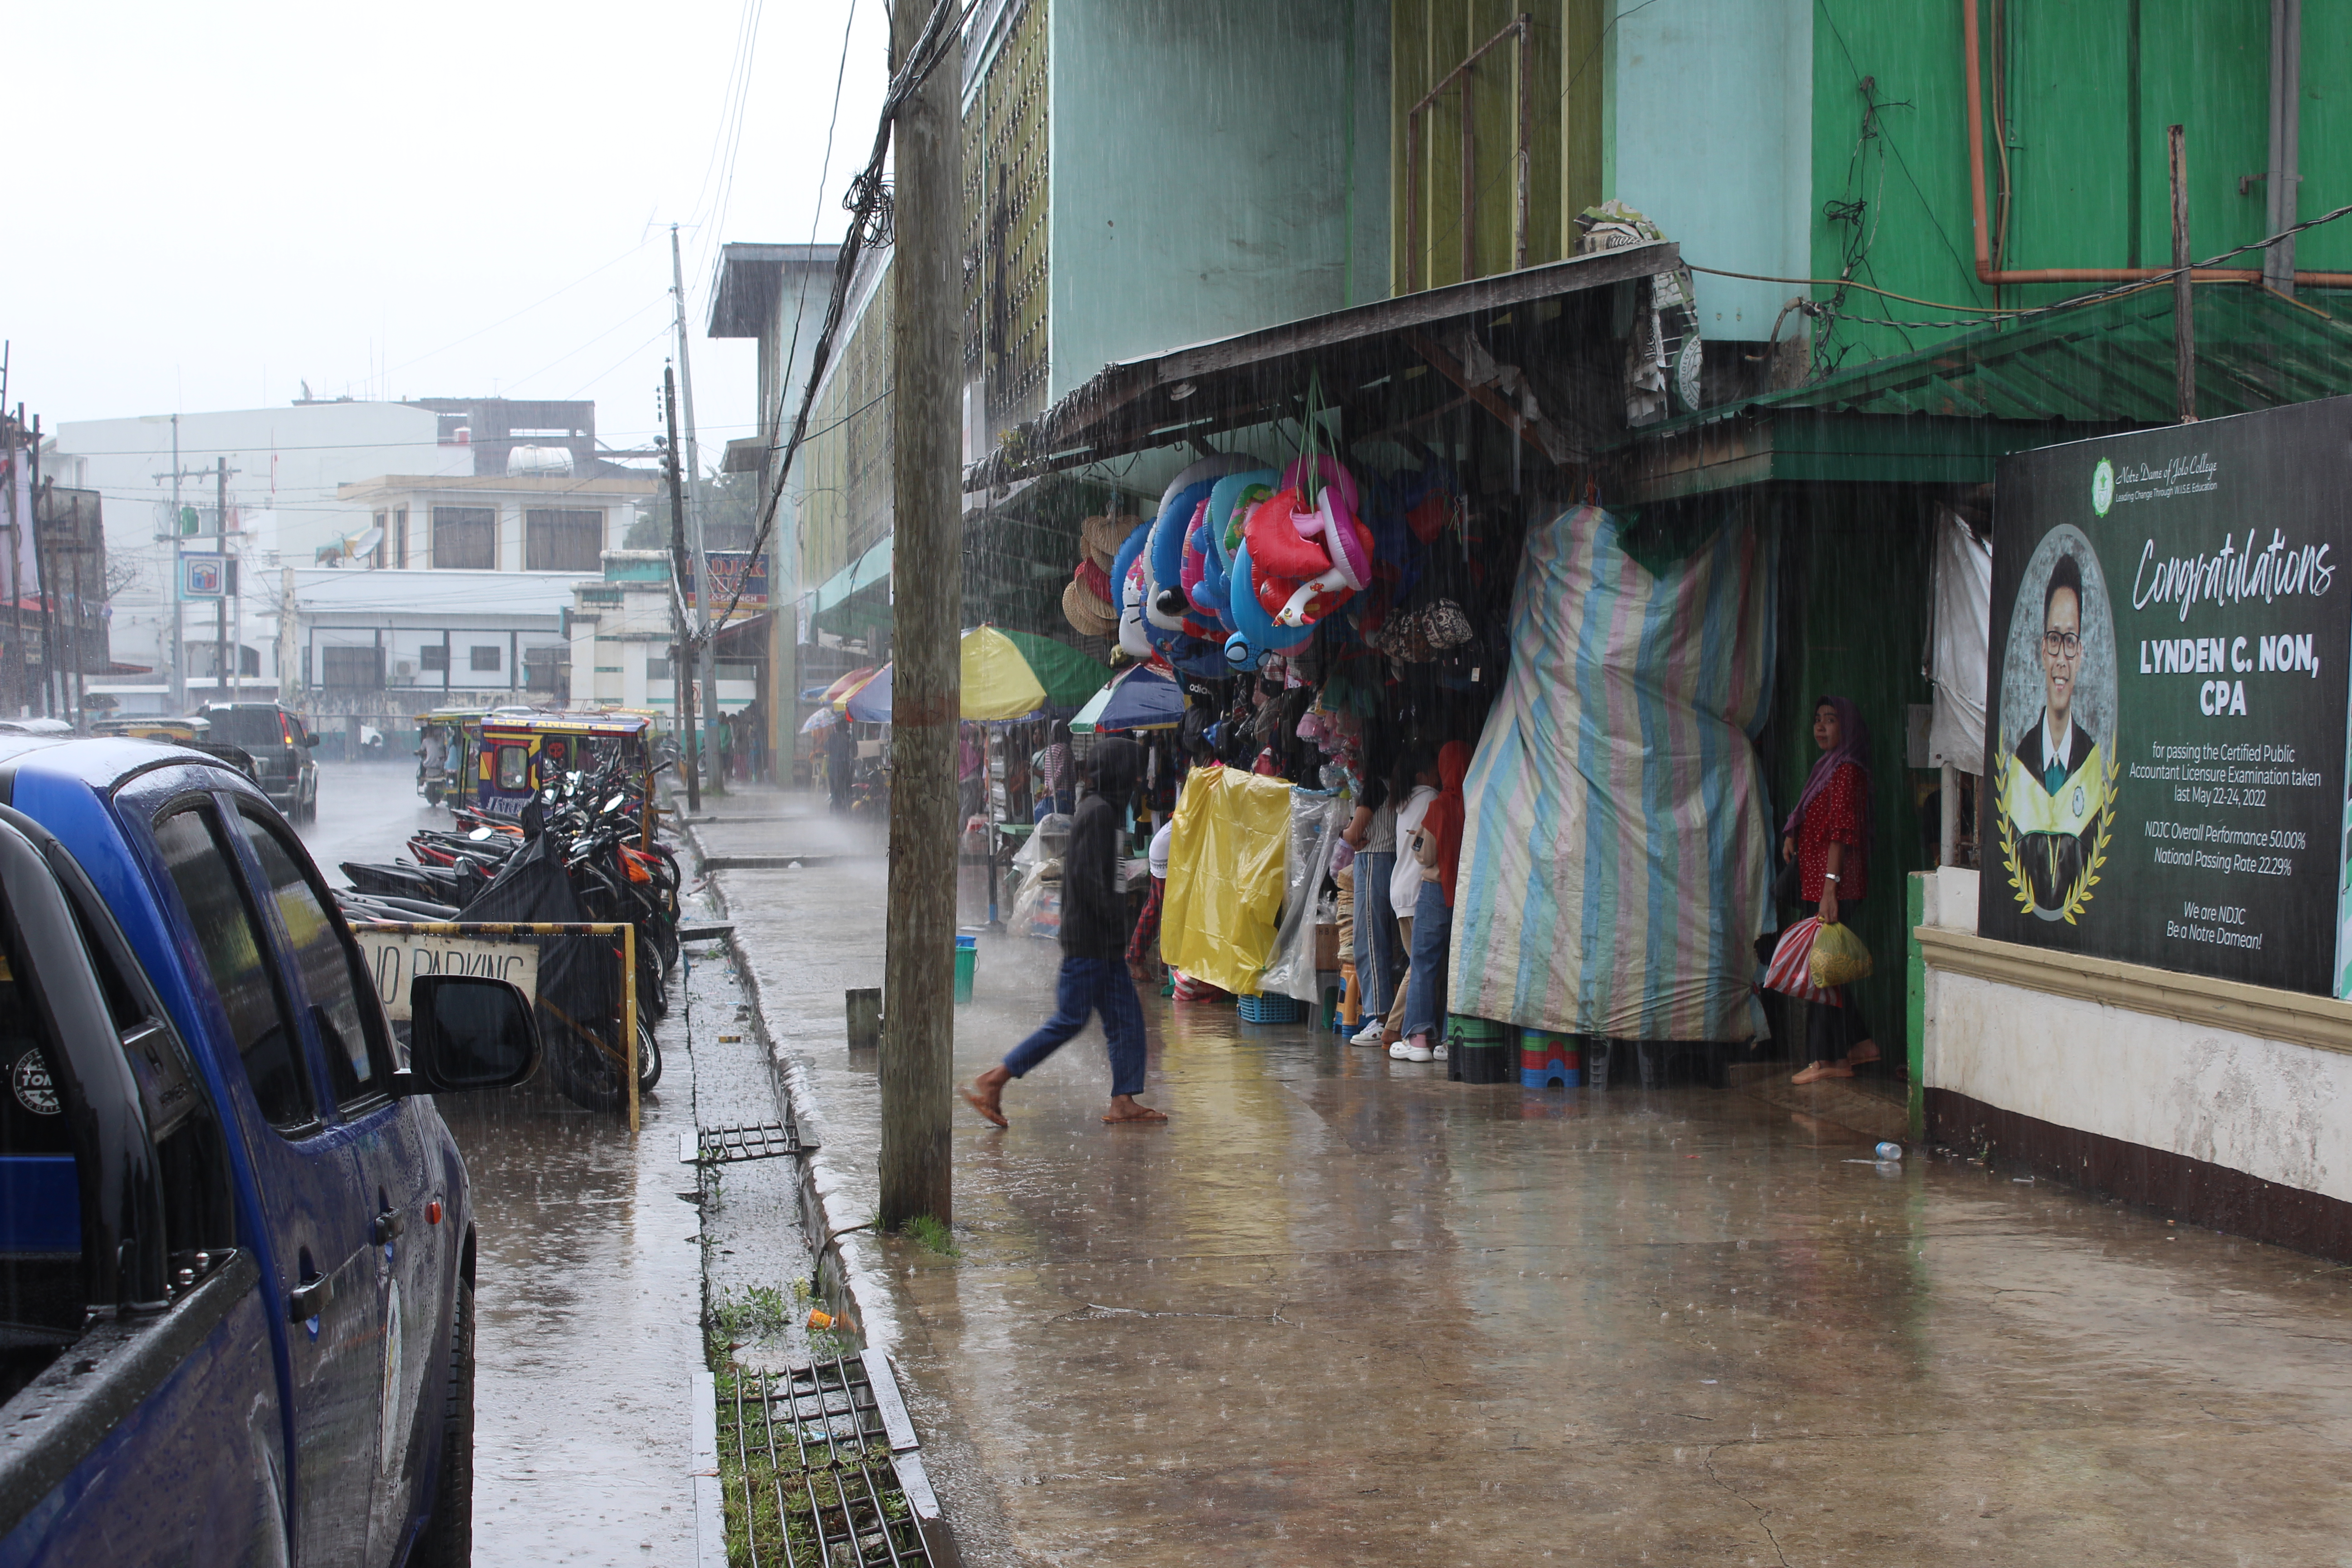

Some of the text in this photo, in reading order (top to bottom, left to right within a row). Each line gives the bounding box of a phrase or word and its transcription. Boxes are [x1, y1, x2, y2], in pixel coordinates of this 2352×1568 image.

[2116, 453, 2217, 486] Notre Dame of Jolo College
[2116, 493, 2134, 502] Leading
[2135, 490, 2152, 500] Change
[2153, 488, 2173, 499] Through
[2192, 482, 2217, 493] Education
[2132, 528, 2335, 622] Congratulations
[2140, 634, 2319, 678] LYNDEN C. NON,
[2200, 680, 2246, 716] CPA
[2152, 741, 2295, 764] for passing the Certified Public
[2129, 763, 2321, 786] Accountant Licensure Examination taken
[2174, 785, 2266, 808] last May 22-24, 2022
[2145, 821, 2306, 849] NDJC Overall Performance 50.00%
[2154, 847, 2292, 876] National Passing Rate 22.29%
[2184, 901, 2246, 925] We are NDJC
[2166, 921, 2262, 950] Be a Notre Damean!
